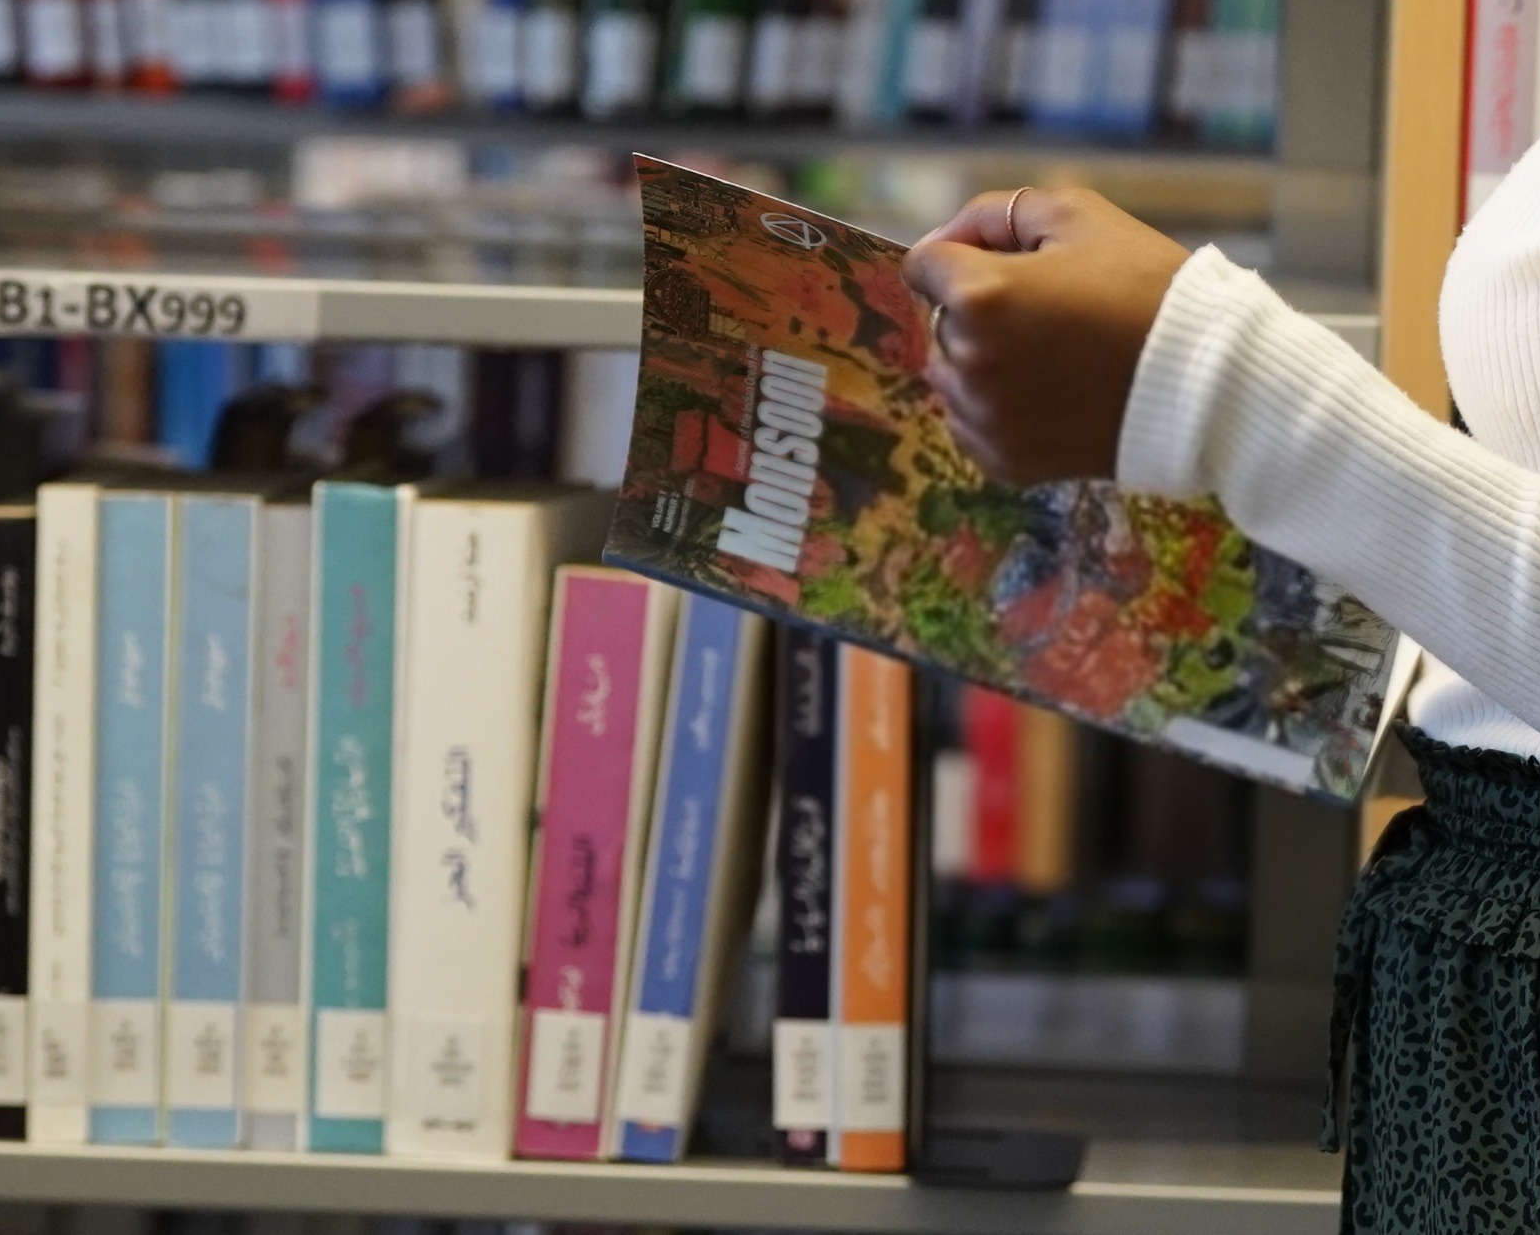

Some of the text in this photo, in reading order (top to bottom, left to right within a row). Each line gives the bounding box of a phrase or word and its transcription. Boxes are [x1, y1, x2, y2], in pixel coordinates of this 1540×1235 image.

[744, 360, 758, 386] Ocean
[742, 386, 756, 413] Indian
[716, 349, 828, 574] Monsoon
[733, 439, 750, 476] Journal
[651, 495, 667, 528] VOLUME
[662, 498, 679, 533] NUMBER
